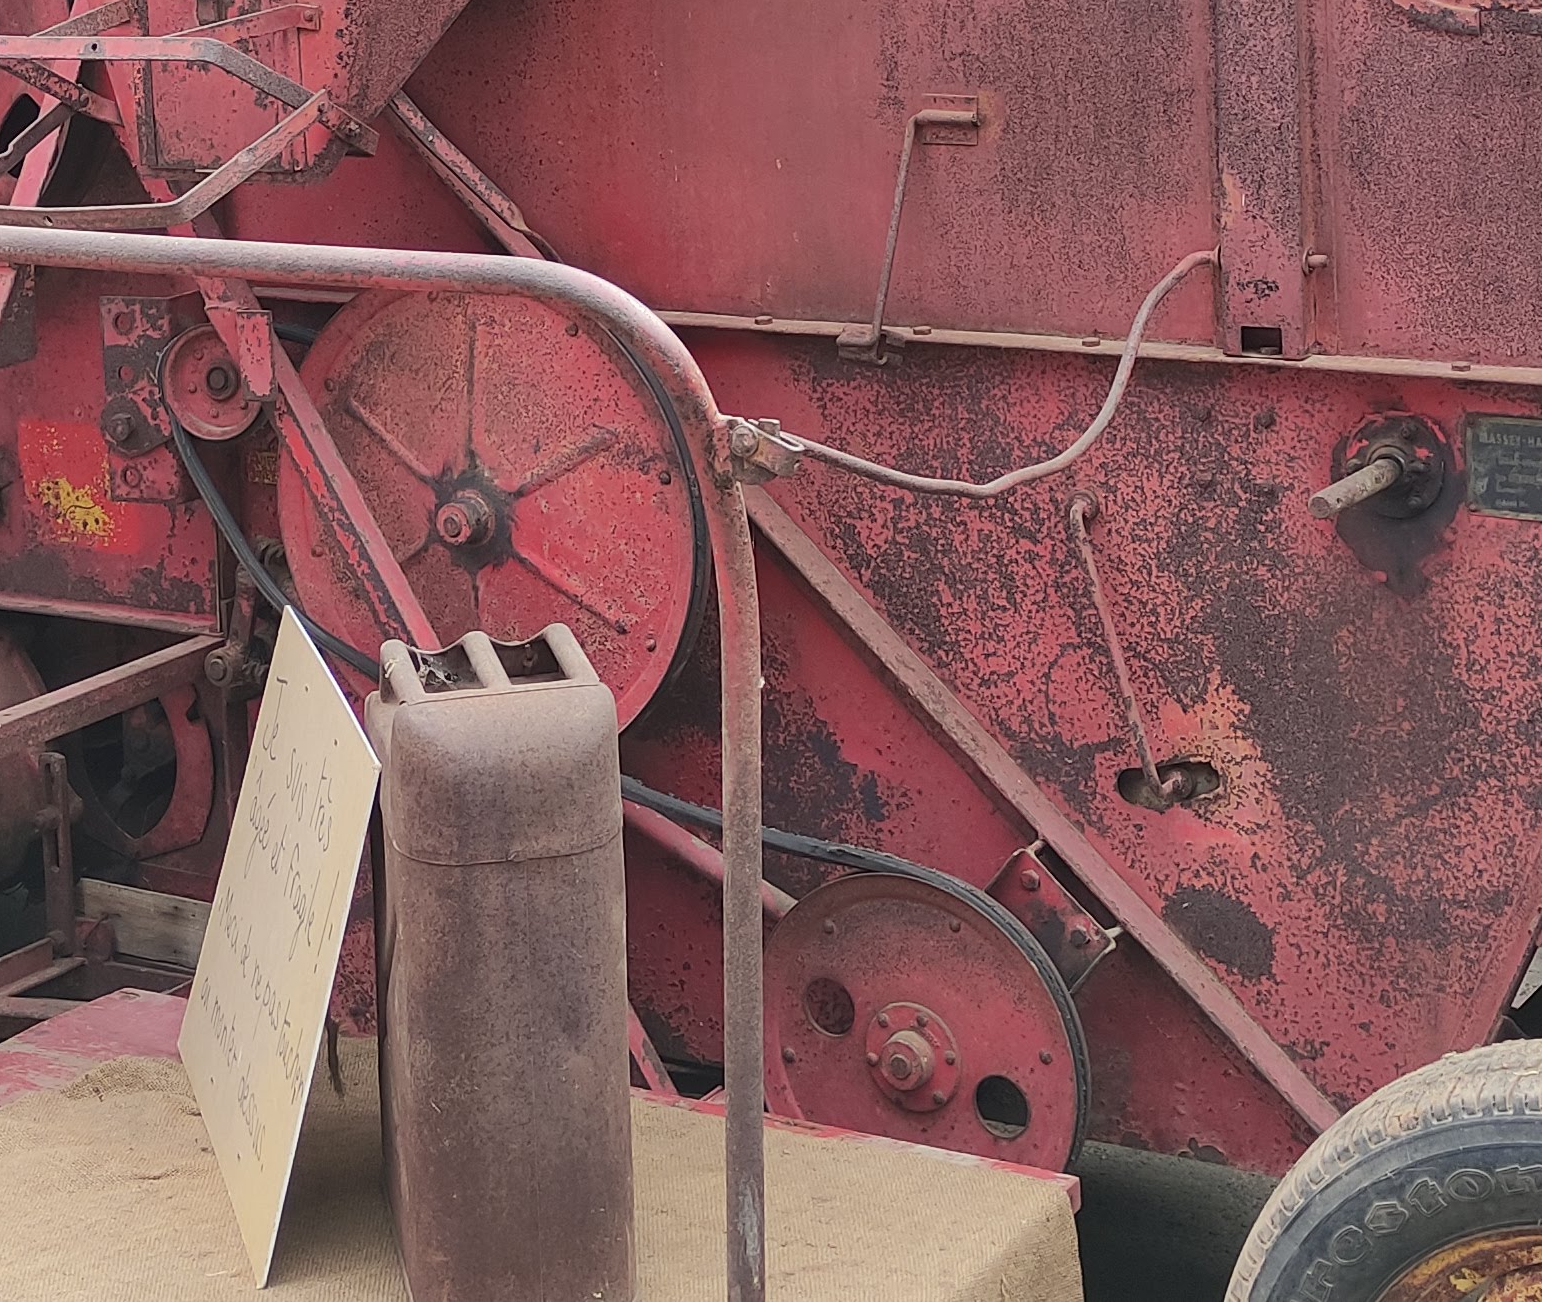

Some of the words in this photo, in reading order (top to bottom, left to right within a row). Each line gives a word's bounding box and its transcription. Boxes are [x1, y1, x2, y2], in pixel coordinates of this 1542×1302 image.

[262, 676, 288, 760] Je
[286, 748, 308, 822] suis
[309, 756, 333, 852] très
[244, 769, 276, 879] âgée
[271, 823, 287, 875] et
[283, 842, 321, 962] fragile
[221, 885, 243, 954] Merci
[240, 924, 252, 979] de
[250, 958, 262, 1001] ne
[252, 979, 282, 1041] pas
[210, 994, 238, 1070] monter
